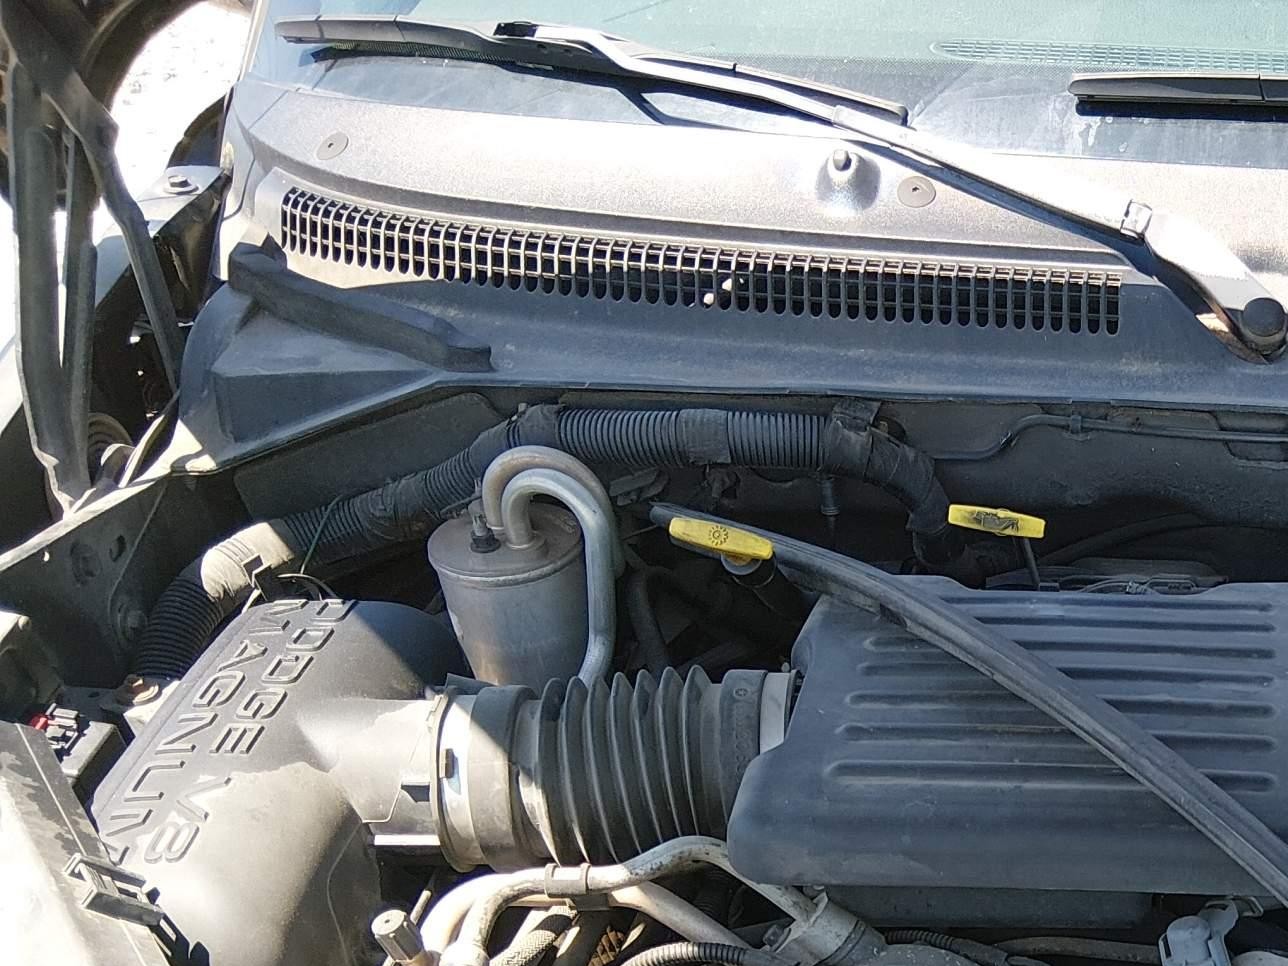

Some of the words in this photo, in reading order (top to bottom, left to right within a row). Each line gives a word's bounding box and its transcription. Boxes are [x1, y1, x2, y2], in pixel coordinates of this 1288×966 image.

[102, 599, 309, 866] MAGNUM
[208, 599, 359, 754] DODGE
[144, 777, 231, 864] V8
